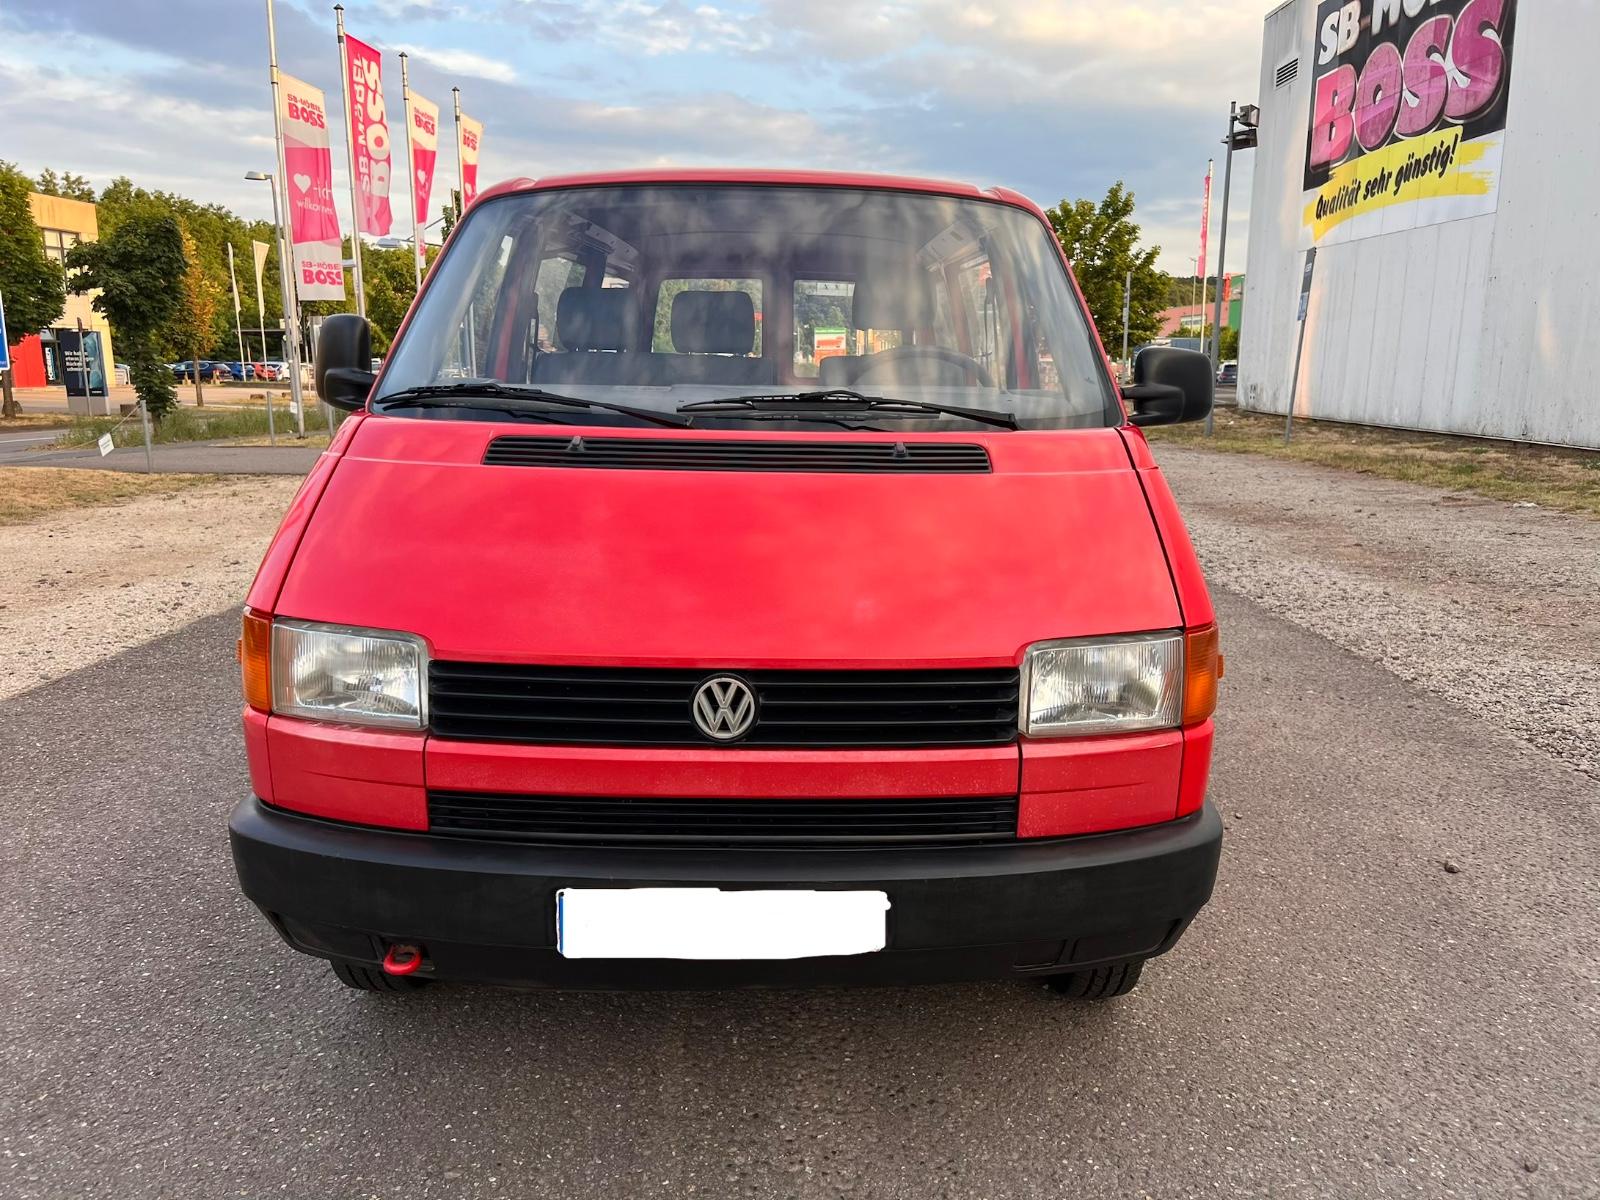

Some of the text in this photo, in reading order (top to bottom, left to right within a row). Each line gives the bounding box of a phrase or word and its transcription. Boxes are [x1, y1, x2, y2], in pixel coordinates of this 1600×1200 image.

[288, 102, 325, 129] BOSS
[1309, 0, 1507, 173] BOSS
[363, 56, 390, 198] BOSS
[1315, 132, 1459, 220] Qualität sehr günstig!
[302, 269, 343, 286] BOSS
[693, 678, 755, 739] VW
